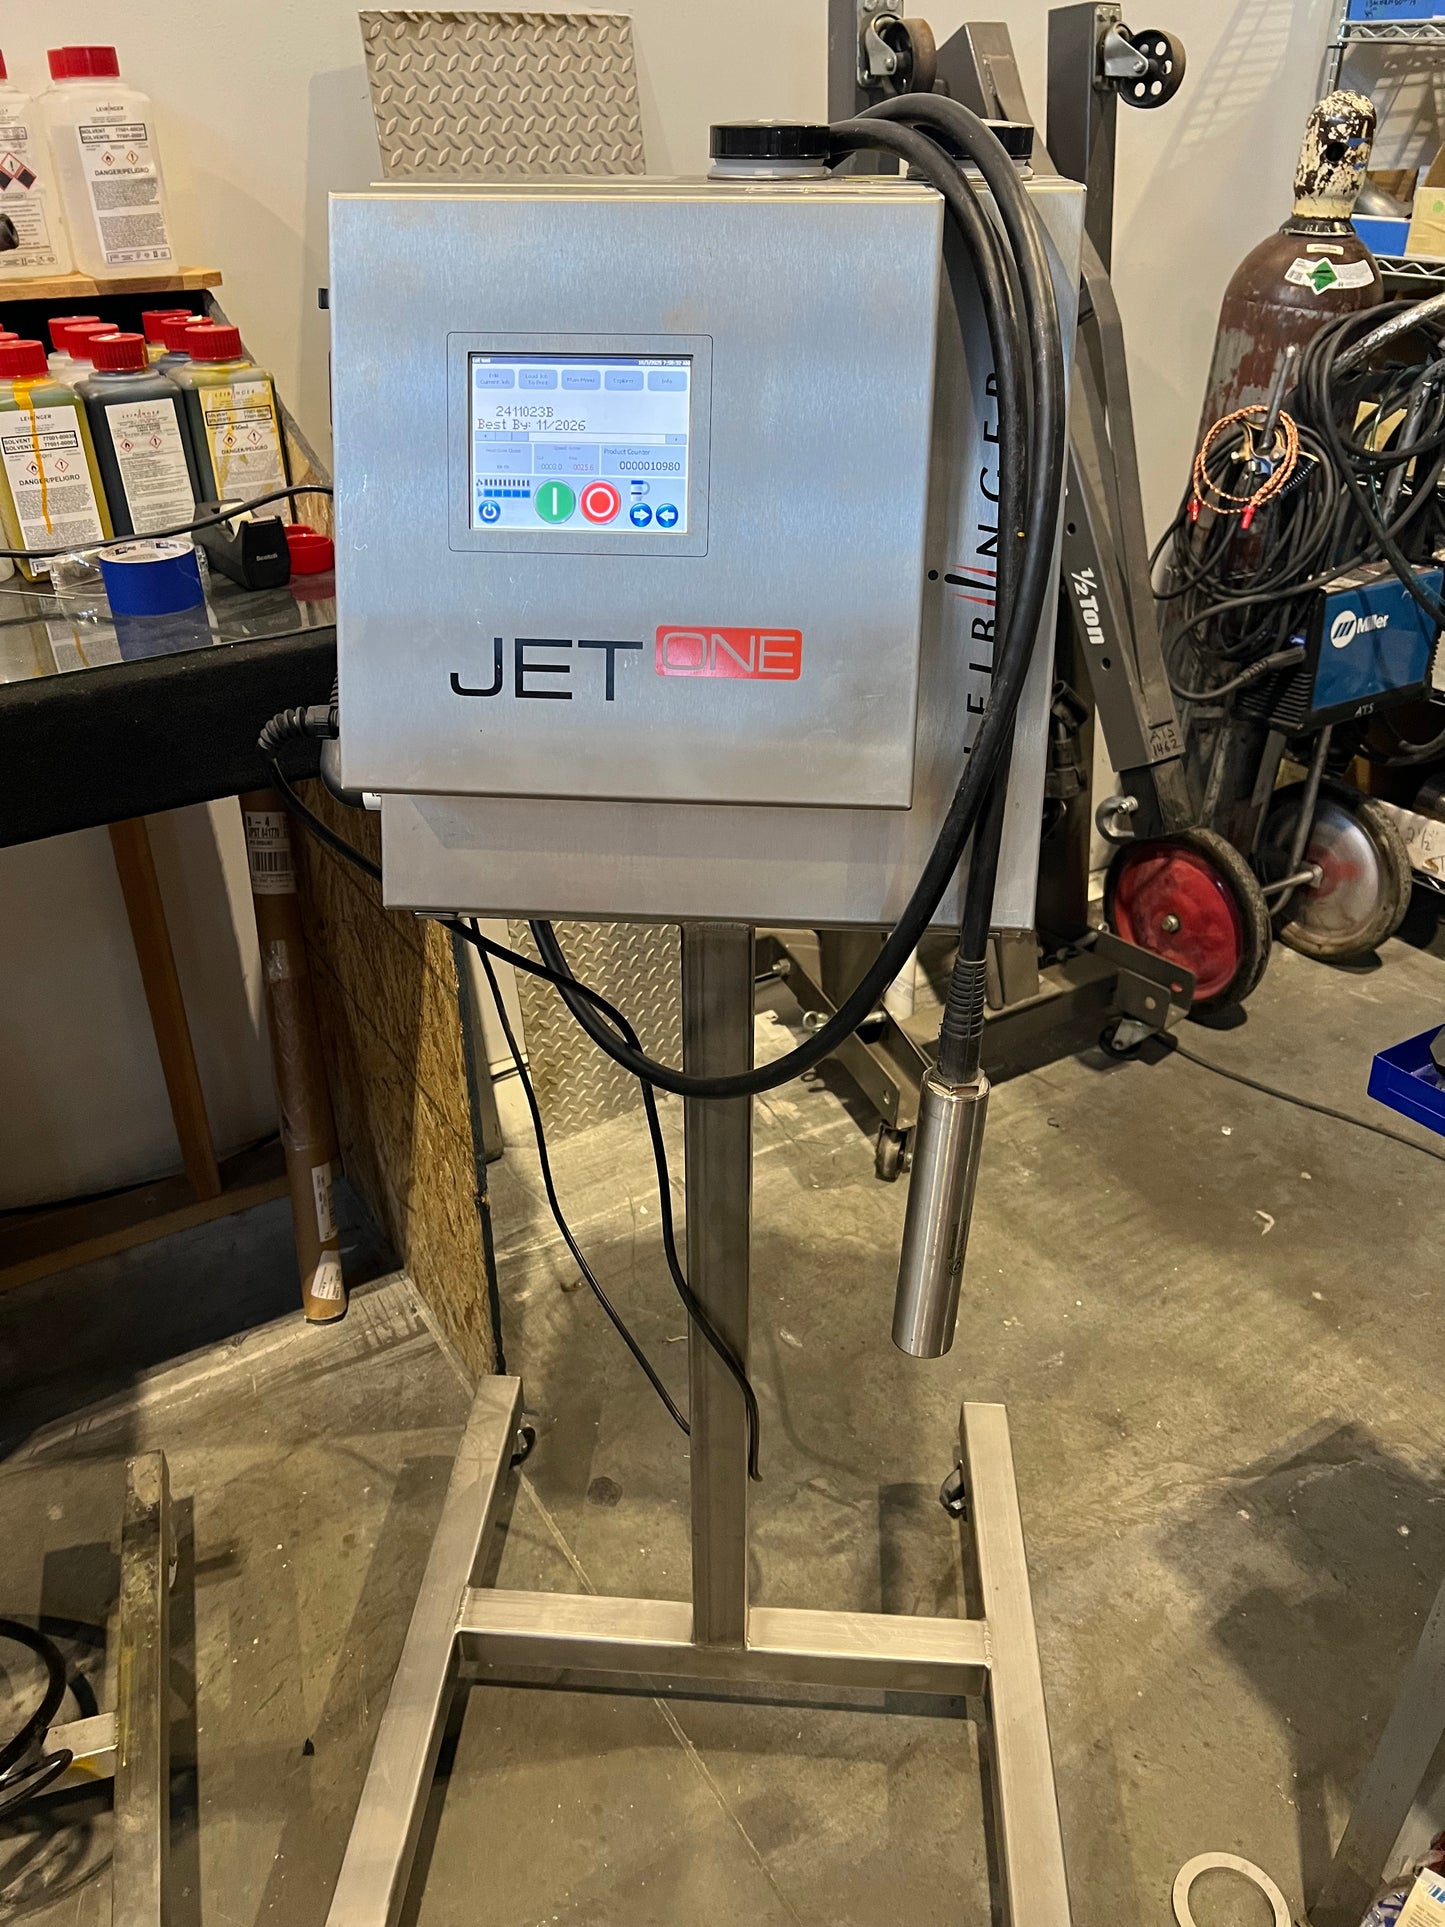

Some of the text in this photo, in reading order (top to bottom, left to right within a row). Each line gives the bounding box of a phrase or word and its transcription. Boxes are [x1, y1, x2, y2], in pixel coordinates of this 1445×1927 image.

[496, 406, 554, 417] 2411023B
[477, 419, 586, 431] Best By: 11/2026
[619, 461, 681, 471] 0000010980
[256, 553, 278, 561] Scotch
[1079, 595, 1105, 645] Ton
[1357, 614, 1389, 634] Miller
[450, 631, 796, 701] JET ONE
[1354, 703, 1374, 718] ATS
[1152, 738, 1184, 757] 1462
